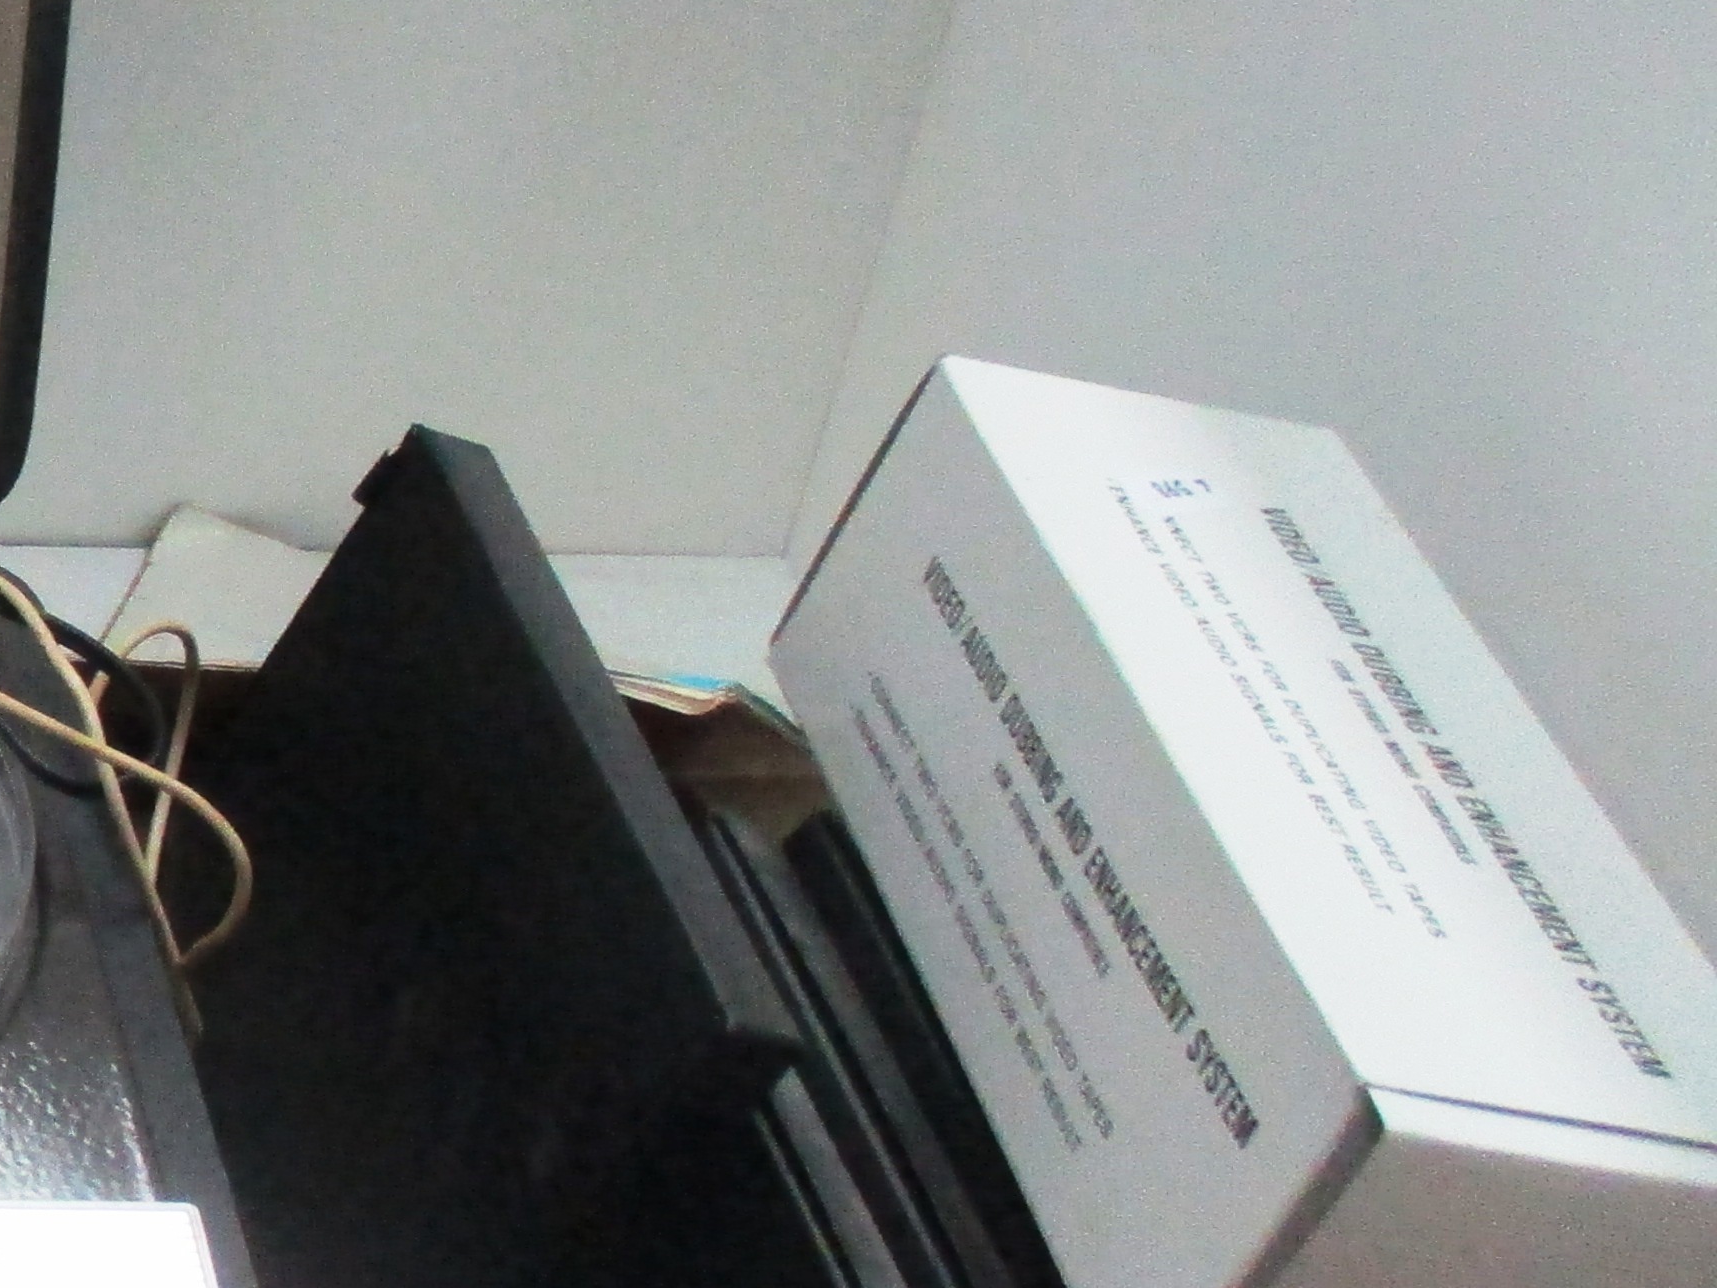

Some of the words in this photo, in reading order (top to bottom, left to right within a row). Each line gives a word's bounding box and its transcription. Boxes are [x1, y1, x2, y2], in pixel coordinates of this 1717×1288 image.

[1105, 483, 1167, 556] ENHANCE
[1273, 749, 1314, 786] FOR
[1300, 791, 1348, 839] BEST
[1332, 841, 1397, 915] RESULT
[1251, 658, 1289, 692] FOR
[1276, 697, 1366, 811] DUPLICATING
[1352, 816, 1407, 875] VIDEO
[1393, 880, 1451, 942] TAPES
[1347, 641, 1440, 737] DUBBING
[1414, 740, 1477, 790] AND
[1451, 793, 1601, 971] ENHANCEMENT
[1574, 976, 1676, 1081] SYSTEM
[997, 690, 1066, 808] DUBBING
[1053, 789, 1096, 861] AND
[1082, 842, 1197, 1040] ENHANCEMENT
[1183, 1022, 1261, 1154] SYSTEM
